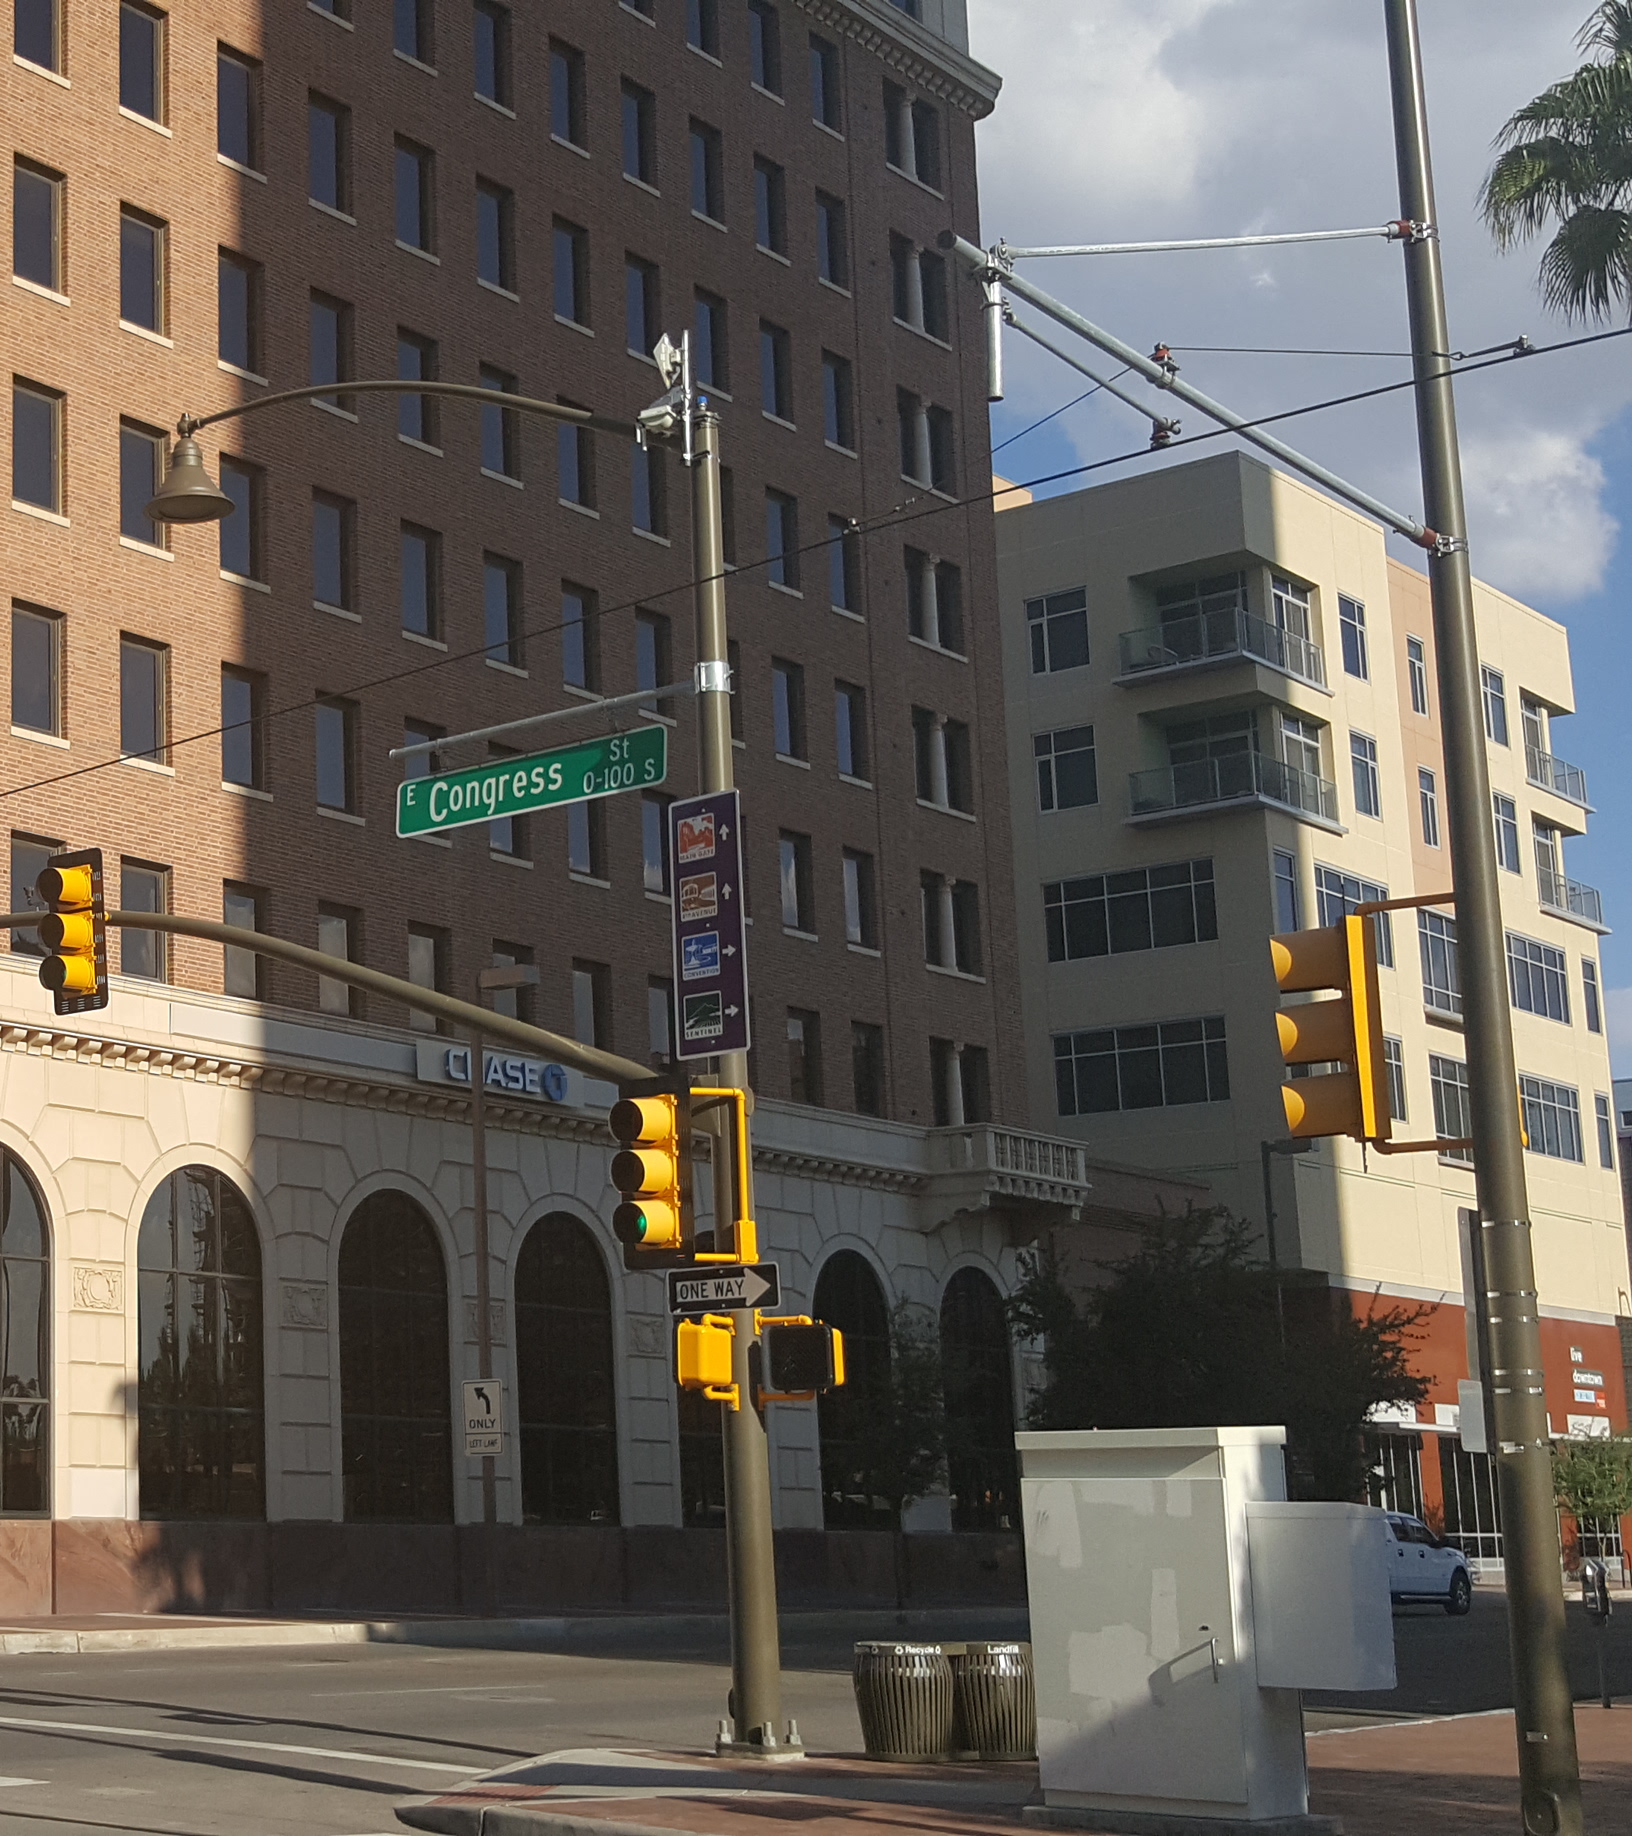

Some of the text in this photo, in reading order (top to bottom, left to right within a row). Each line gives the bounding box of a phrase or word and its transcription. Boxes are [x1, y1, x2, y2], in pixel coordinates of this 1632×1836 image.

[609, 738, 629, 761] St
[583, 758, 655, 794] 0-100 S
[406, 763, 563, 823] E Congress
[684, 968, 719, 979] CONVENTION
[686, 1026, 721, 1038] SENTINEL
[679, 1279, 744, 1300] ONE WAY
[469, 1419, 496, 1429] ONLY
[905, 1645, 934, 1655] Recycle
[988, 1644, 1019, 1654] Landfill
